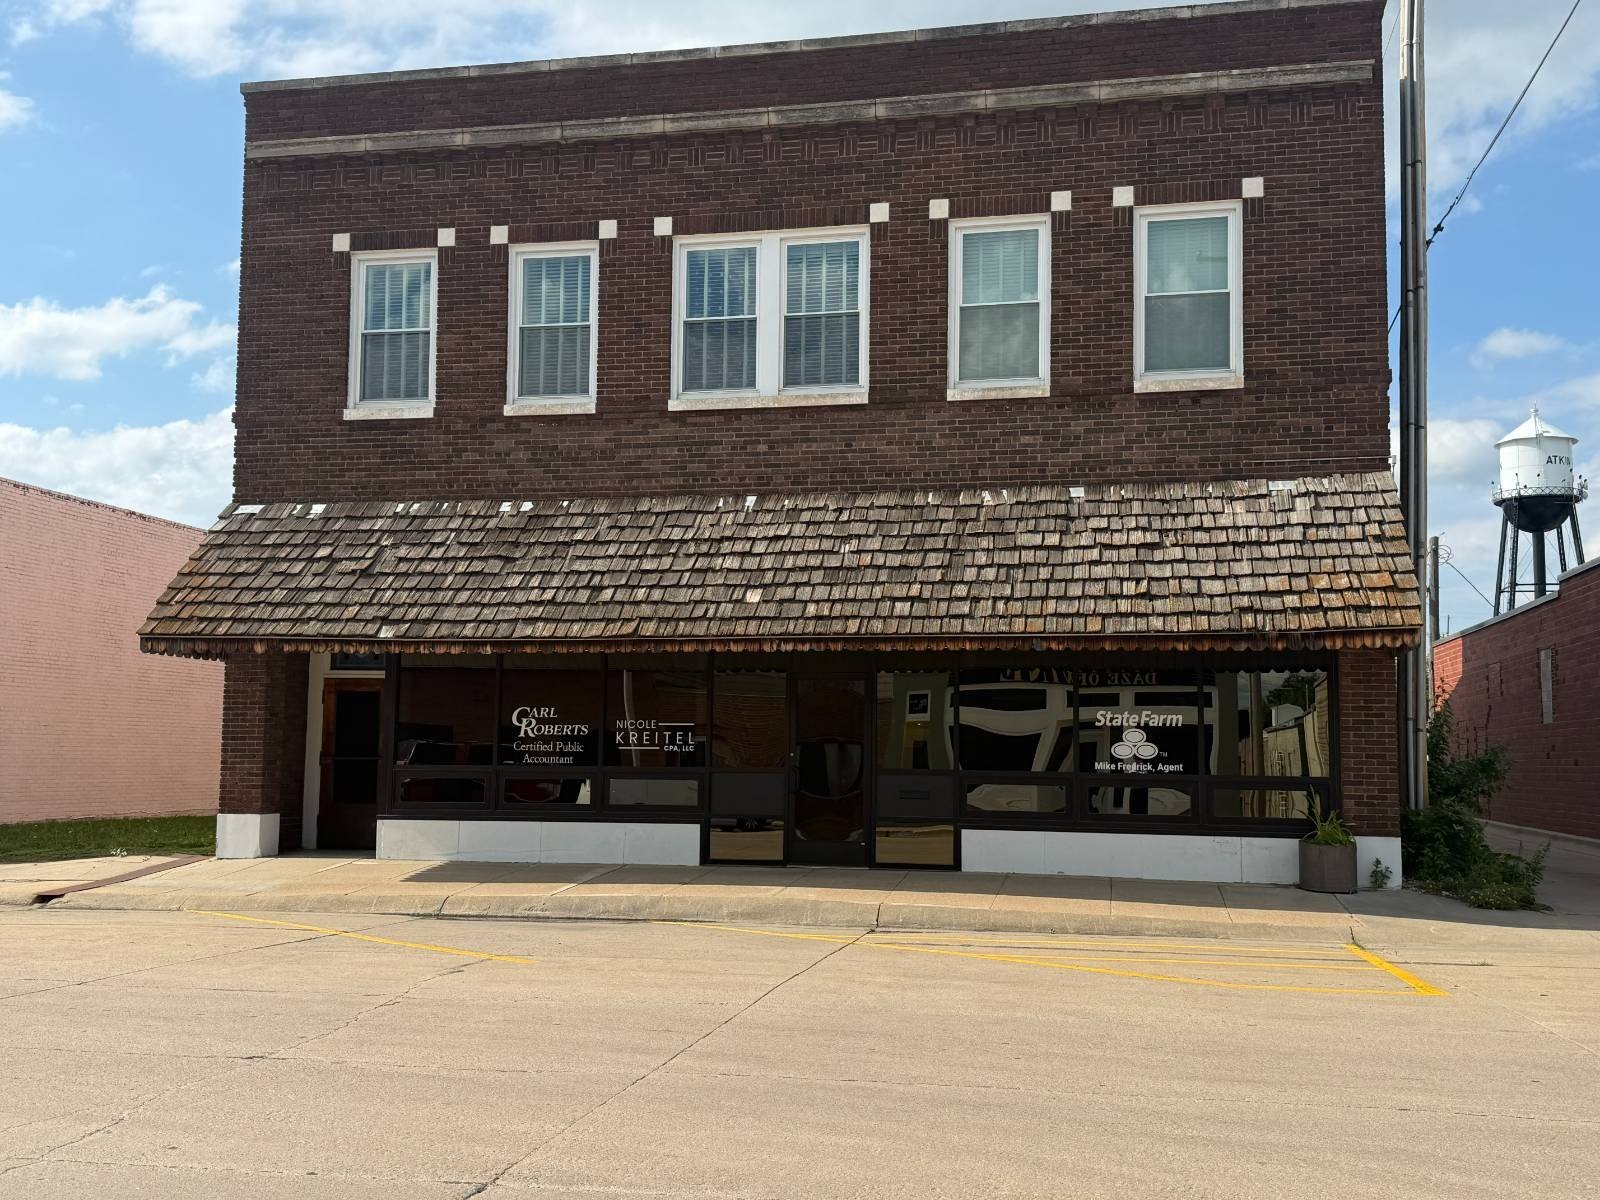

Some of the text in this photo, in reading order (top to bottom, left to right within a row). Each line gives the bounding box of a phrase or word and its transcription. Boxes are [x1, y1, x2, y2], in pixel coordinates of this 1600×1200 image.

[512, 706, 558, 727] CARL
[518, 718, 589, 738] ROBERTS
[616, 719, 657, 729] NICOLE
[615, 731, 695, 744] KREITEL
[513, 741, 585, 752] Certified Public
[522, 754, 573, 764] Accountant
[1094, 761, 1116, 770] Mike
[1157, 763, 1184, 772] Agent
